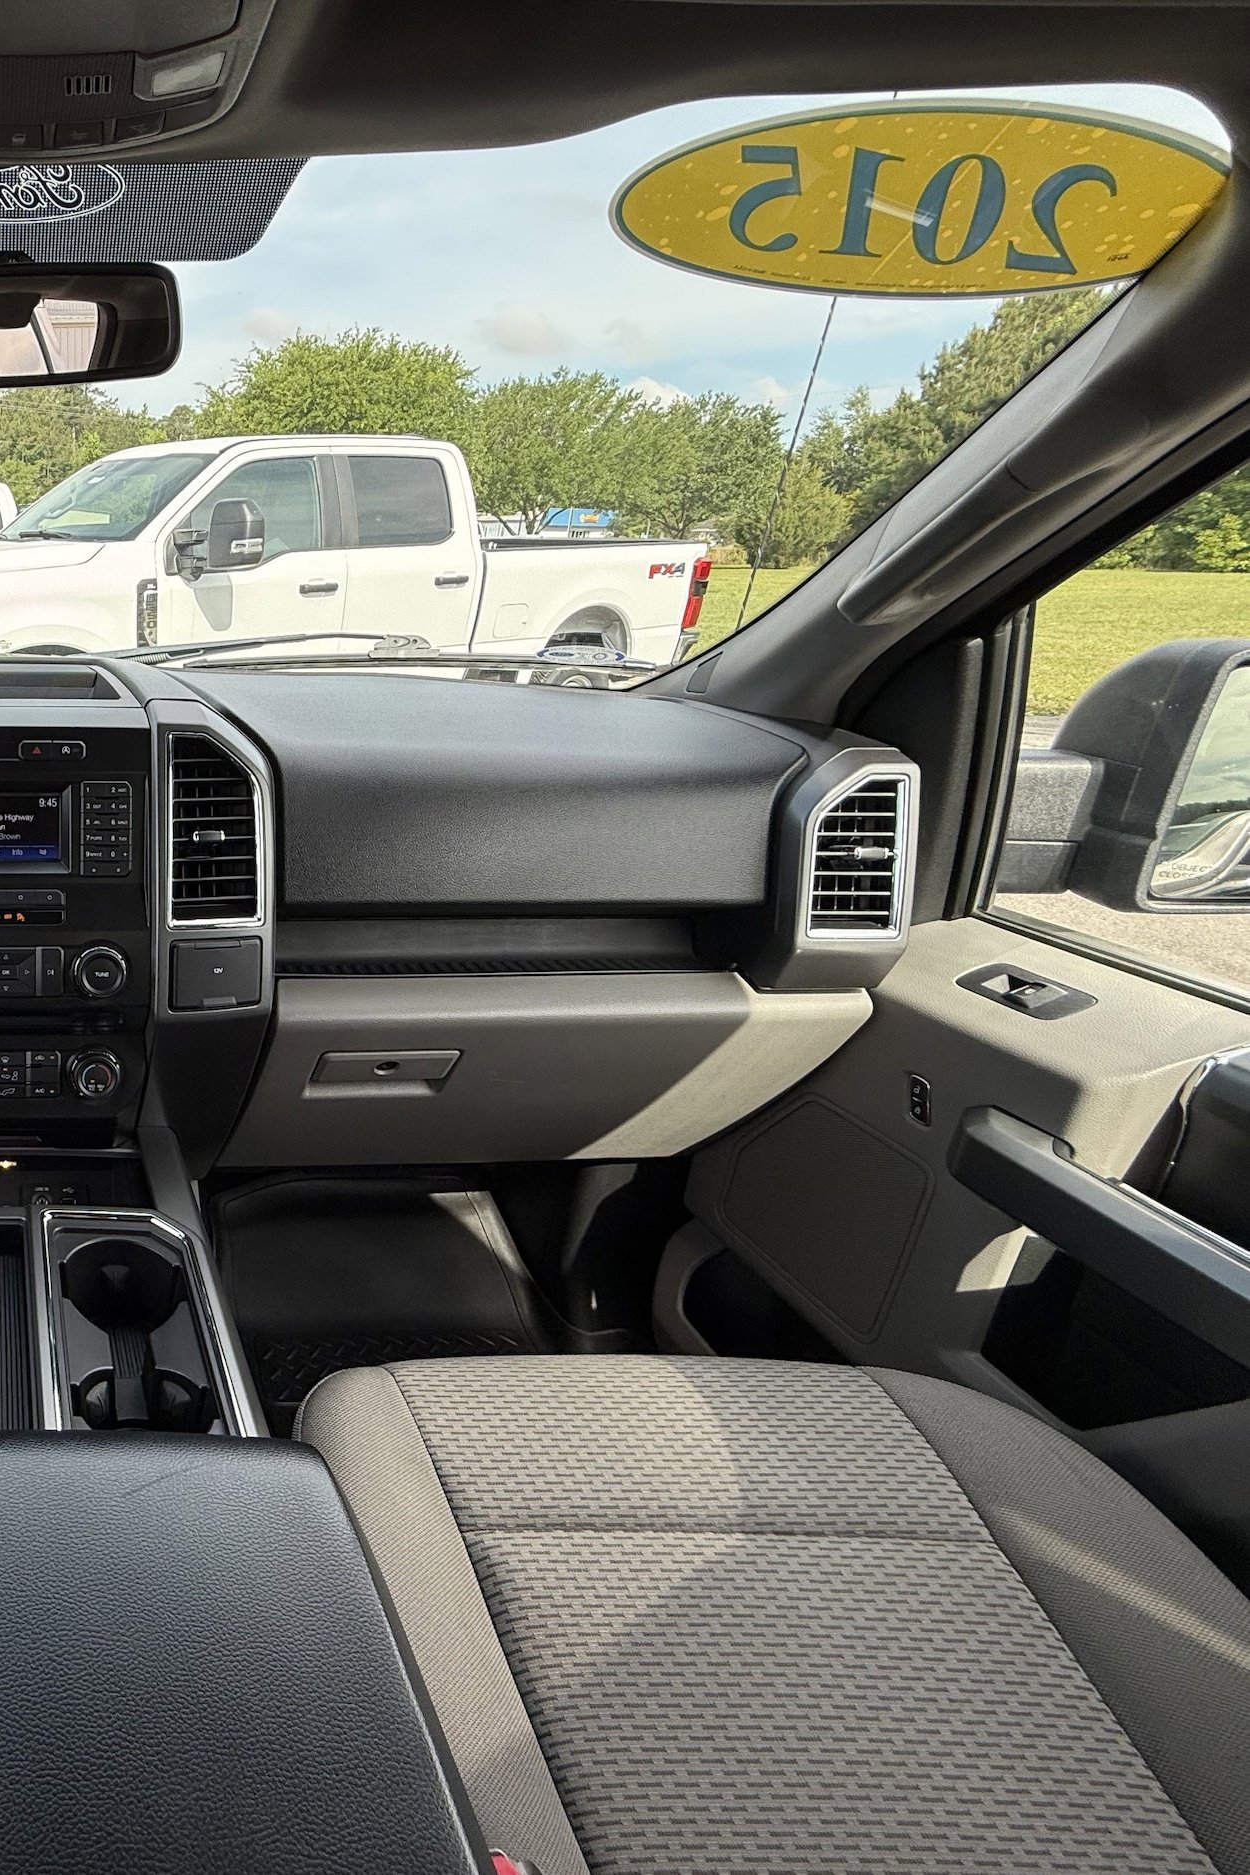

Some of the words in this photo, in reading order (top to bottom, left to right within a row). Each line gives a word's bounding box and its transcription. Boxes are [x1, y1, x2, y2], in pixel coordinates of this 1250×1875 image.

[648, 562, 686, 579] FX4
[38, 797, 58, 808] 9:45
[4, 813, 35, 823] Highway
[11, 848, 24, 856] Info
[1171, 862, 1220, 875] OBJEC
